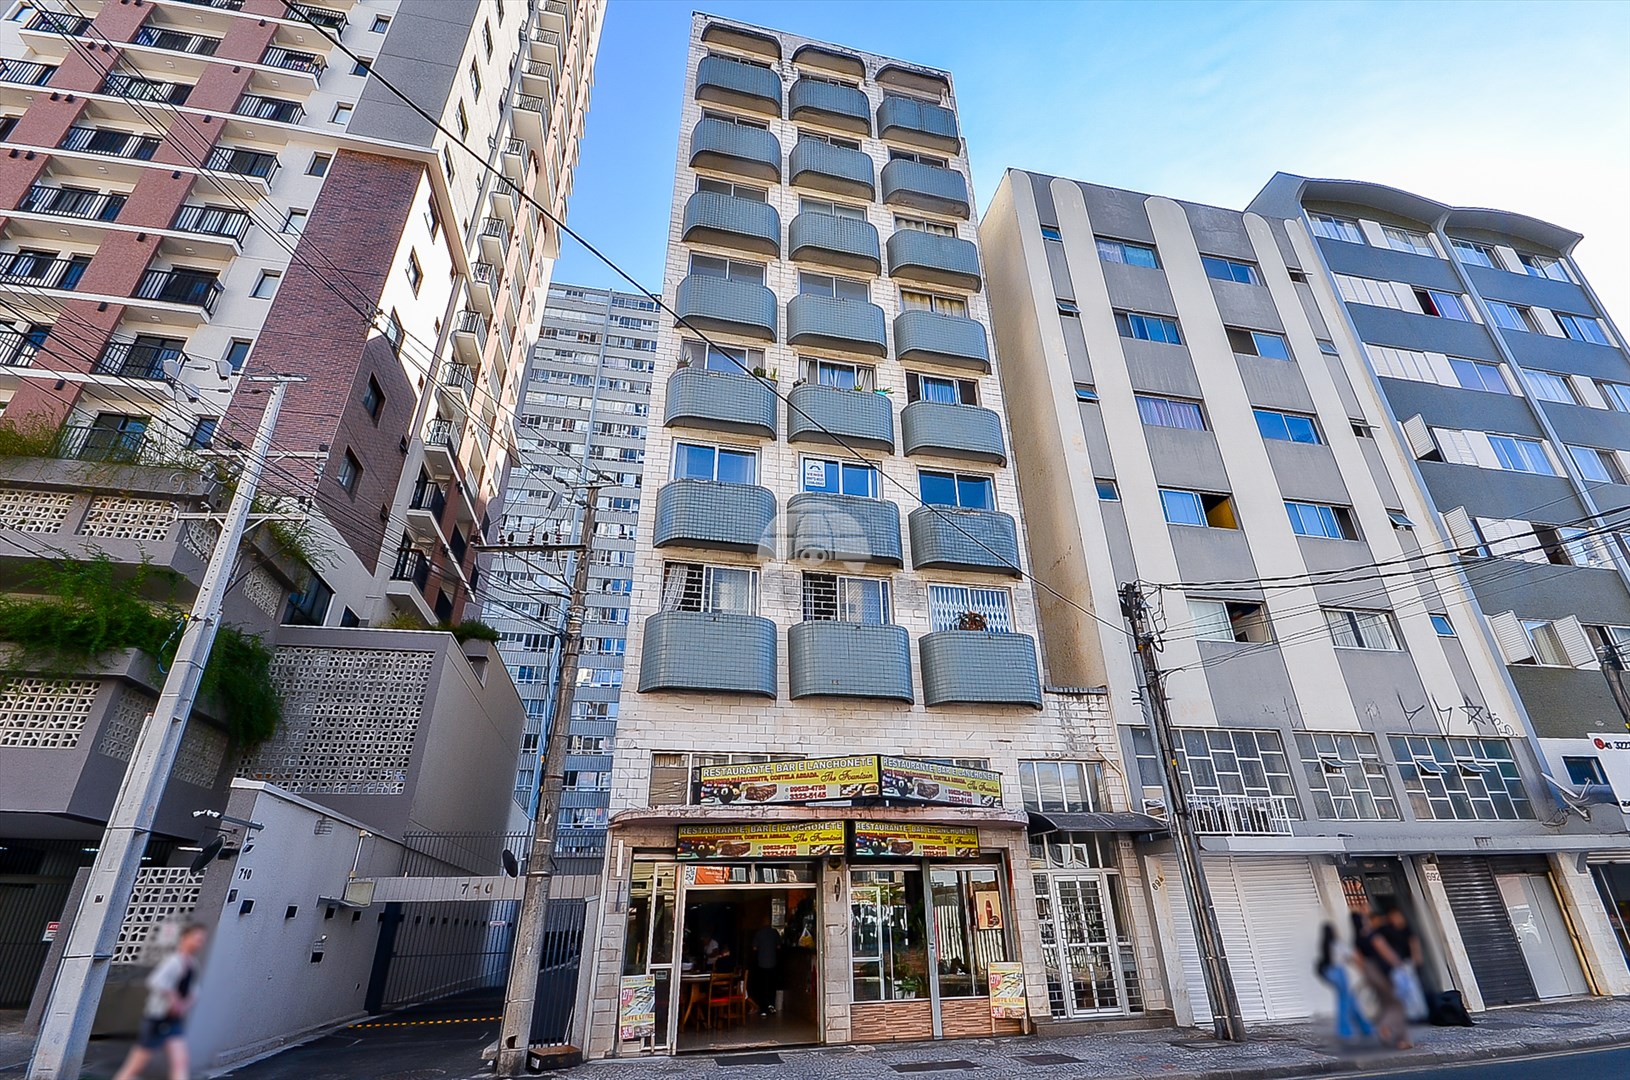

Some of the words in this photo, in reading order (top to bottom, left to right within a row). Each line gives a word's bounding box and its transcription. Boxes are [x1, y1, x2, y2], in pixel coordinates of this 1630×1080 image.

[703, 764, 774, 777] RESTAURANTE,
[776, 763, 795, 772] BAR
[798, 761, 805, 770] E
[806, 757, 873, 770] LANCHONETE
[882, 757, 935, 772] RESTAURANTE,
[937, 765, 951, 774] BAR
[958, 768, 999, 781] LANCHONETE
[820, 770, 837, 782] The
[680, 826, 748, 835] RESTAURANTE,
[750, 825, 769, 833] BAR
[779, 822, 842, 832] LANCHONETE
[793, 833, 808, 843] The
[238, 868, 253, 880] 710
[1426, 872, 1441, 882] 692
